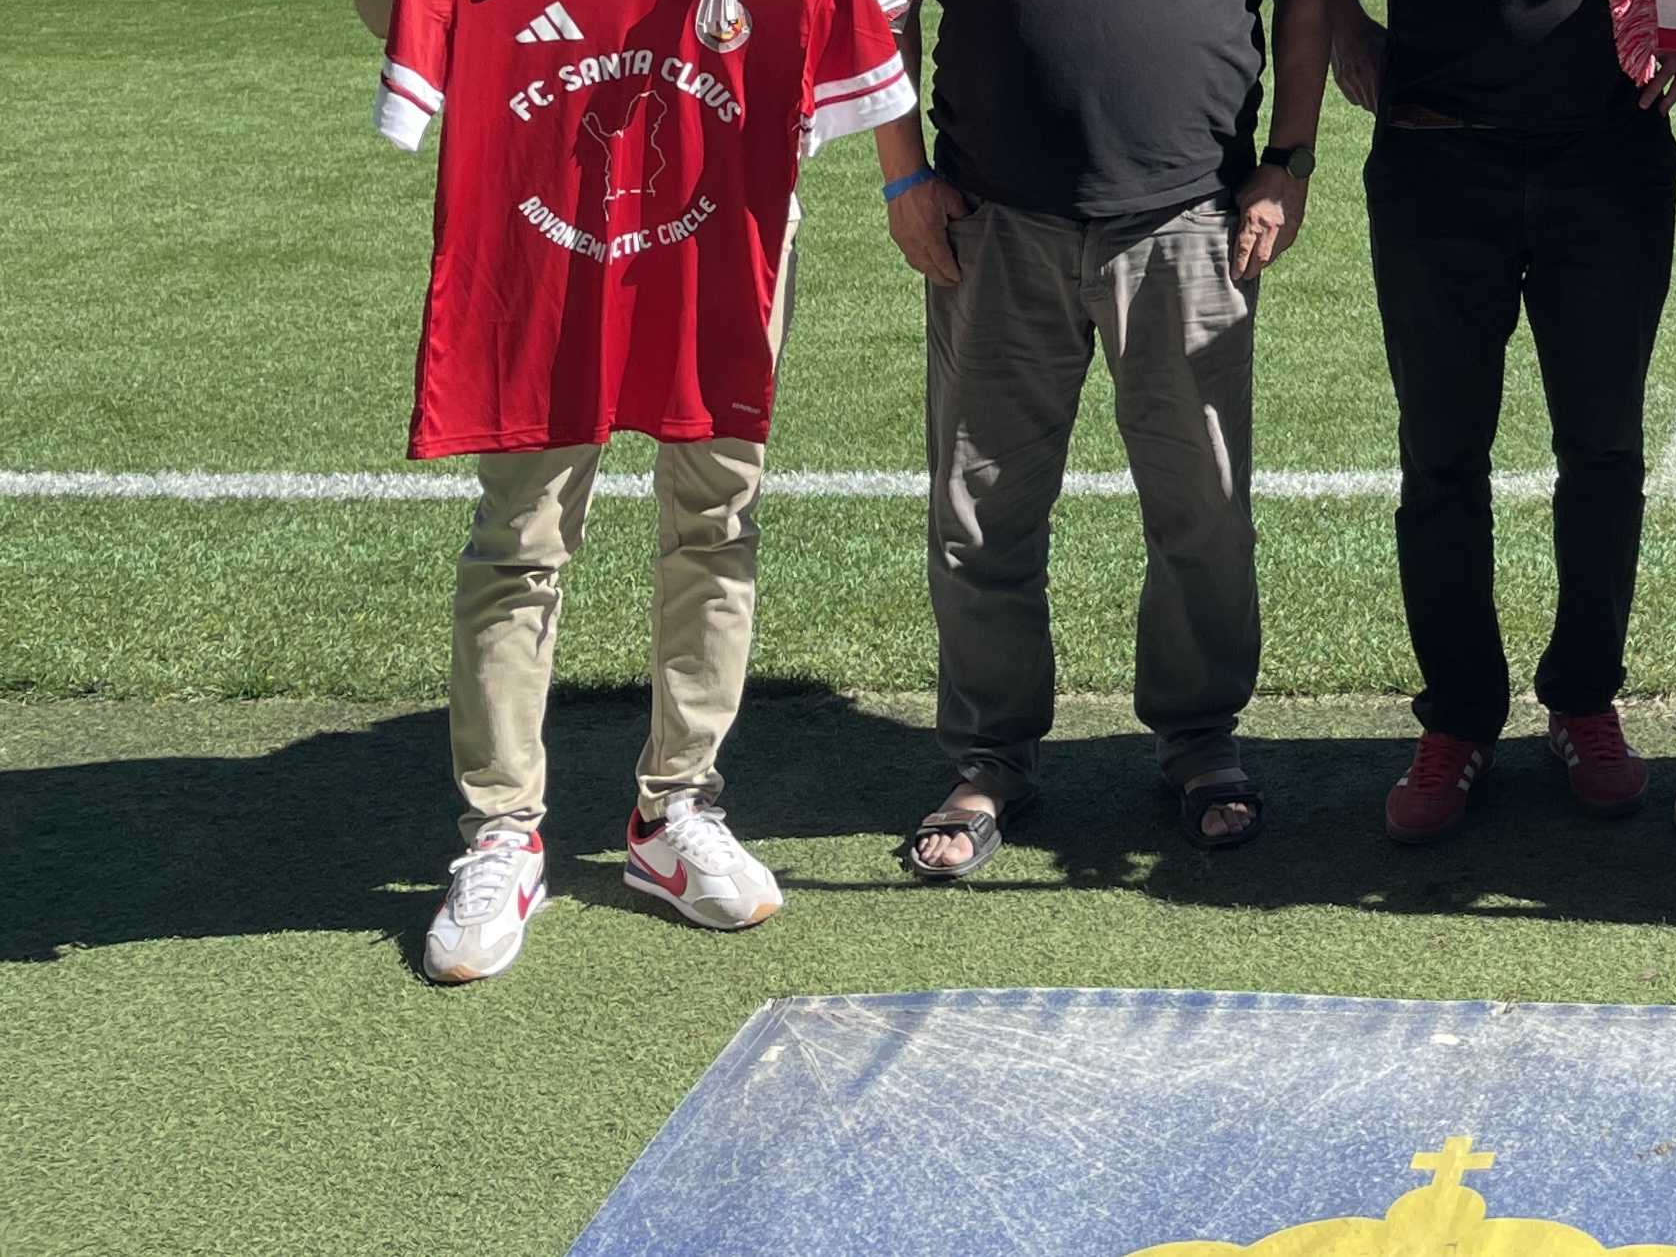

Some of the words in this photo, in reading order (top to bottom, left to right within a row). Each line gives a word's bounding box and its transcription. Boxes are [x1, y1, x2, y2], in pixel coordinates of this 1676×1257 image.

[508, 80, 554, 122] FC
[558, 49, 653, 92] SANTA
[661, 57, 741, 123] CLAUS
[518, 195, 606, 263] ROVANIEMI
[609, 230, 652, 265] CTIC
[656, 195, 717, 245] CIRCLE
